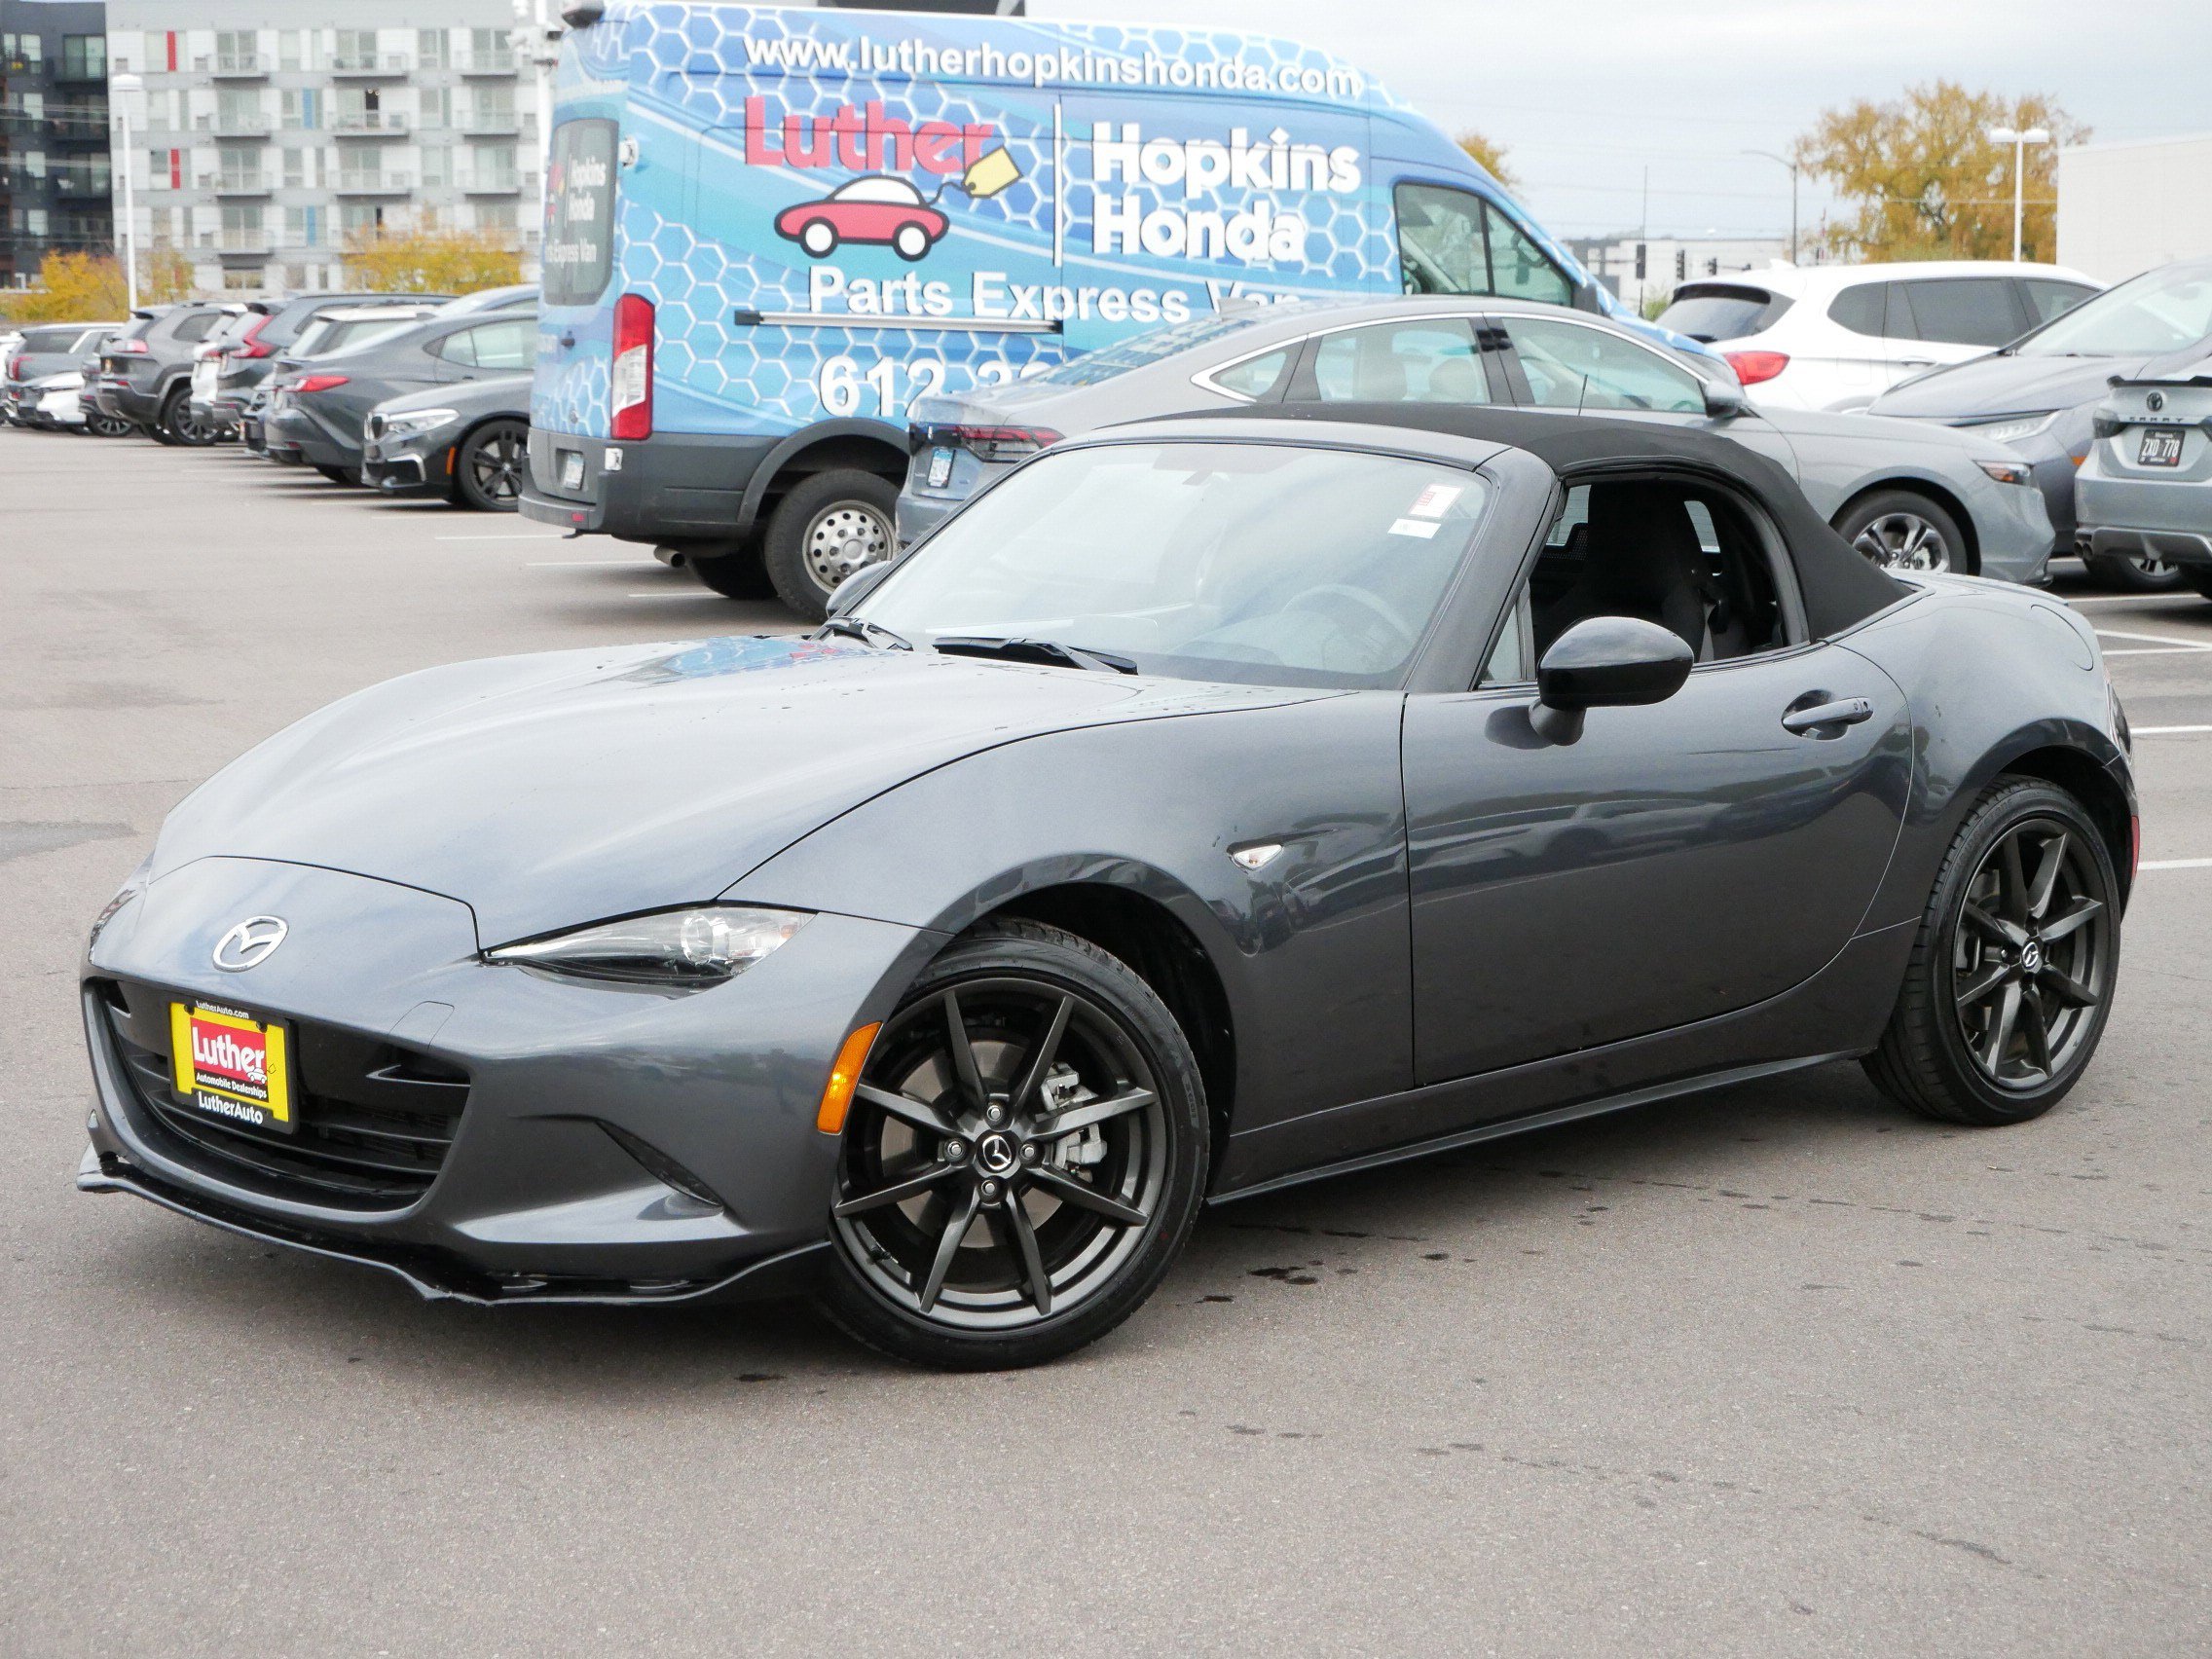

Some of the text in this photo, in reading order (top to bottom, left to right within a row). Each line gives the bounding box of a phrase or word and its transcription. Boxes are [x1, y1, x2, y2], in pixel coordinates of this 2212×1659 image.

[744, 35, 1361, 95] www.lutherhopkinshonda.com
[745, 95, 994, 175] Luther
[1092, 121, 1361, 200] Hopkins
[1092, 194, 1305, 262] Honda
[809, 265, 954, 316] Parts
[973, 271, 1191, 323] Express
[820, 354, 945, 418] 612
[2162, 438, 2180, 458] 778
[196, 1000, 249, 1019] LutherAuto.com
[192, 1026, 265, 1075] Luther
[196, 1072, 268, 1099] Automobile Dealerships
[198, 1090, 264, 1124] LutherAuto
